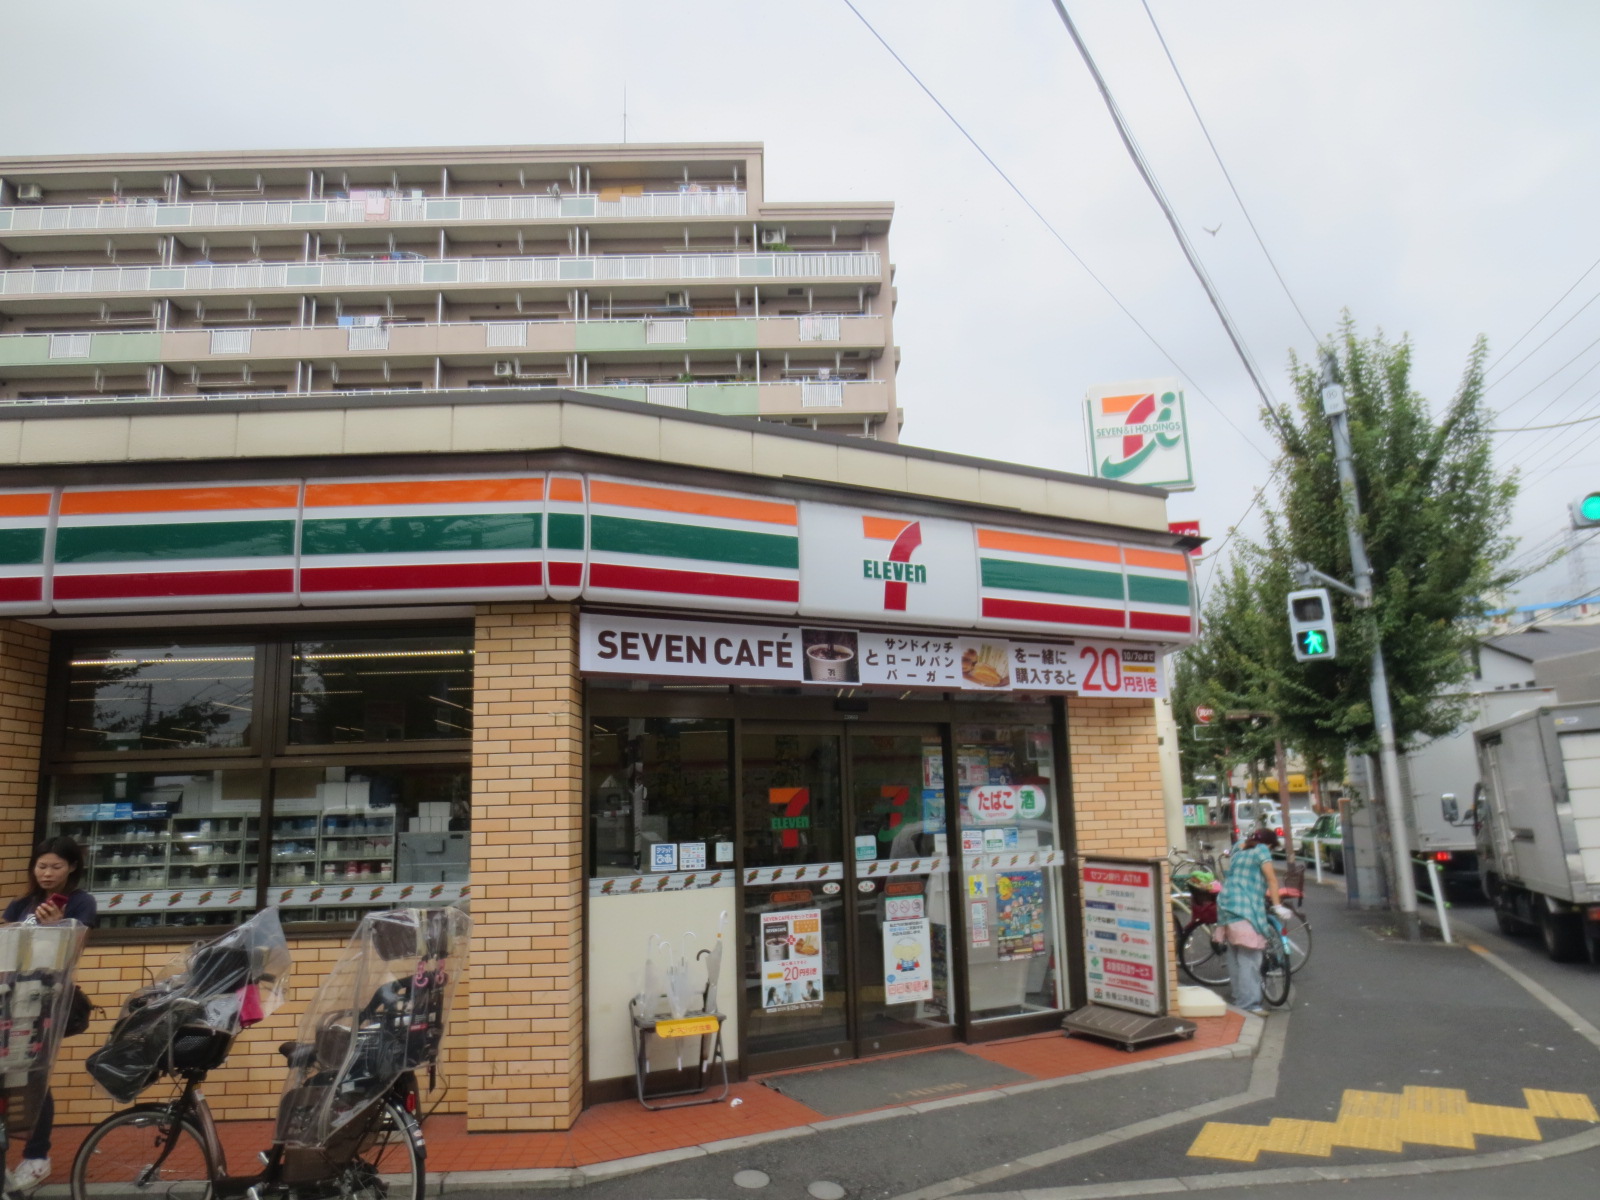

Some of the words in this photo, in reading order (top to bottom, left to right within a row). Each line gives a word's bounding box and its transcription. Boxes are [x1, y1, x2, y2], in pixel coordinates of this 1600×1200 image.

[1135, 421, 1181, 434] HOLDINGS
[597, 630, 707, 665] SEVEN
[714, 633, 794, 669] CAFÉ
[885, 638, 953, 653] サンドイッチ
[866, 649, 879, 666] と
[886, 654, 954, 668] ロールパン
[1015, 648, 1067, 665] を一緒に
[886, 669, 955, 682] バーガー
[1015, 667, 1077, 685] 購入すると
[1080, 646, 1122, 692] 20
[1123, 676, 1157, 692] 円引き
[978, 791, 1014, 811] たばこ
[1020, 790, 1036, 810] 酒
[1123, 873, 1141, 884] ATM
[784, 966, 799, 981] 20
